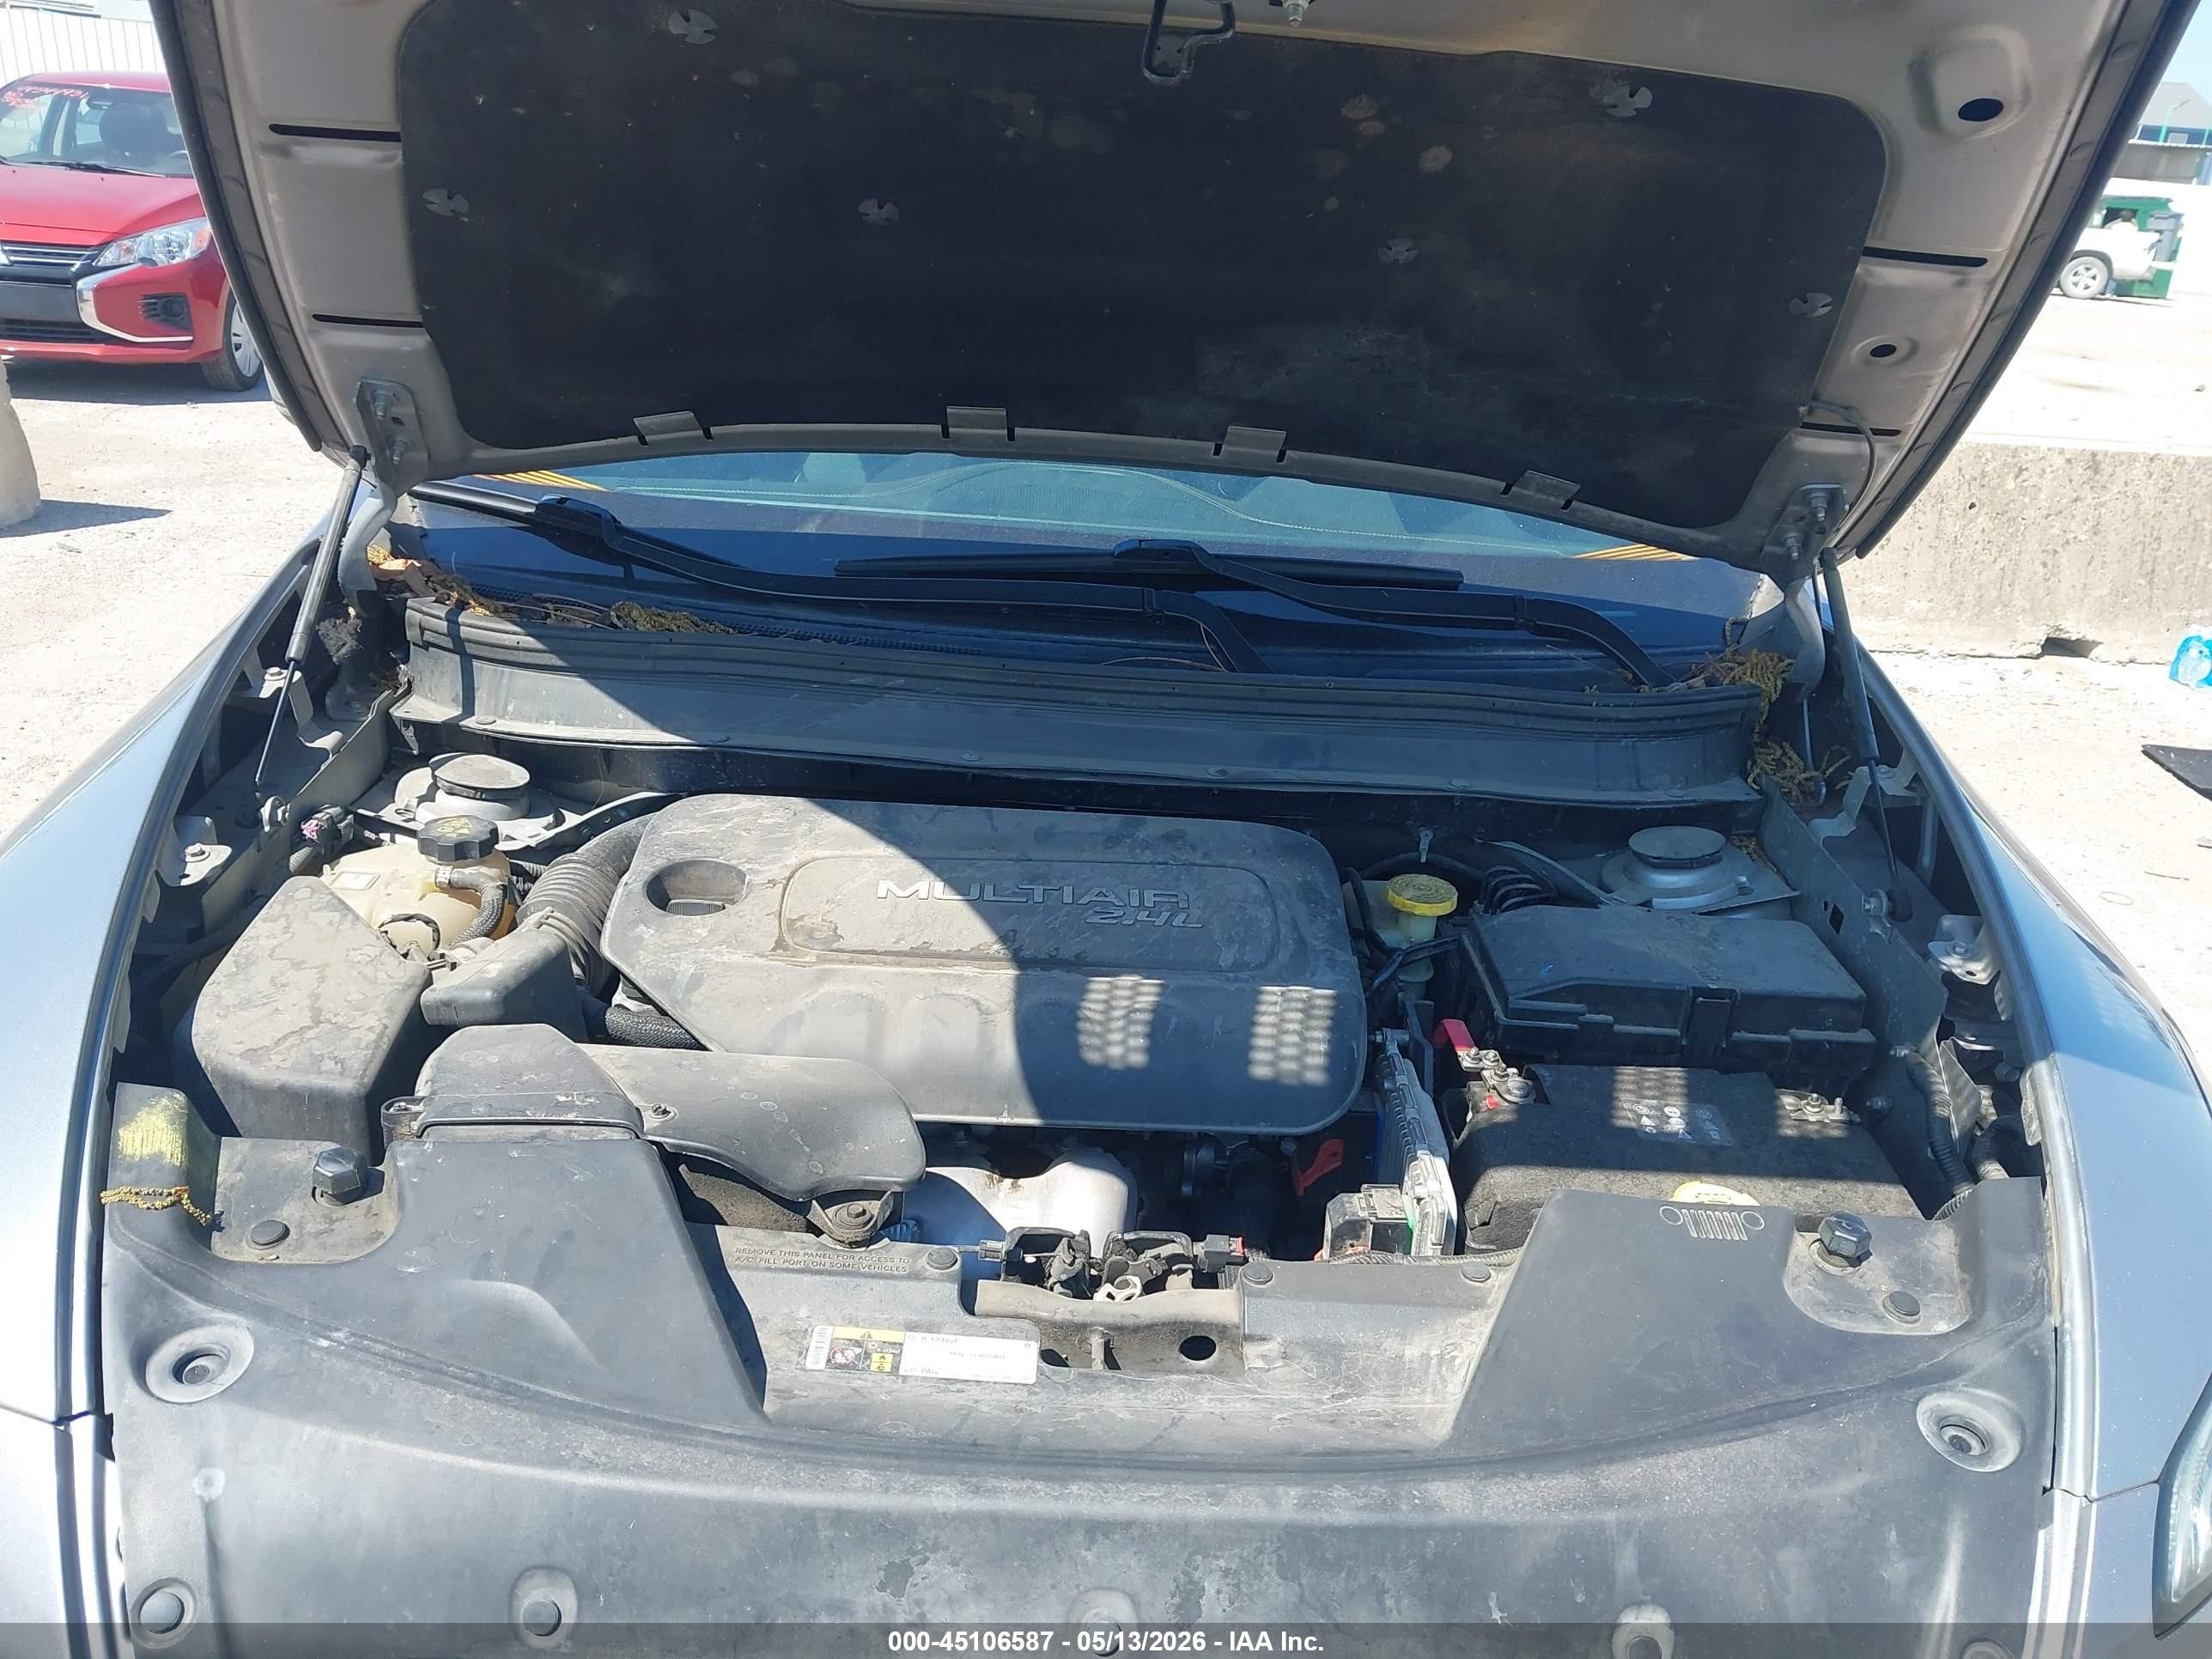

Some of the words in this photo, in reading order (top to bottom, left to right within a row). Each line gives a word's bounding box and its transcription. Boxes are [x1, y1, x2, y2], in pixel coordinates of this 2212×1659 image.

[876, 878, 1190, 909] MULTIAIR
[1085, 907, 1204, 928] 2.4L
[734, 1247, 776, 1256] REMOVE
[803, 1251, 833, 1260] PANEL
[860, 1263, 908, 1273] VEHICLES
